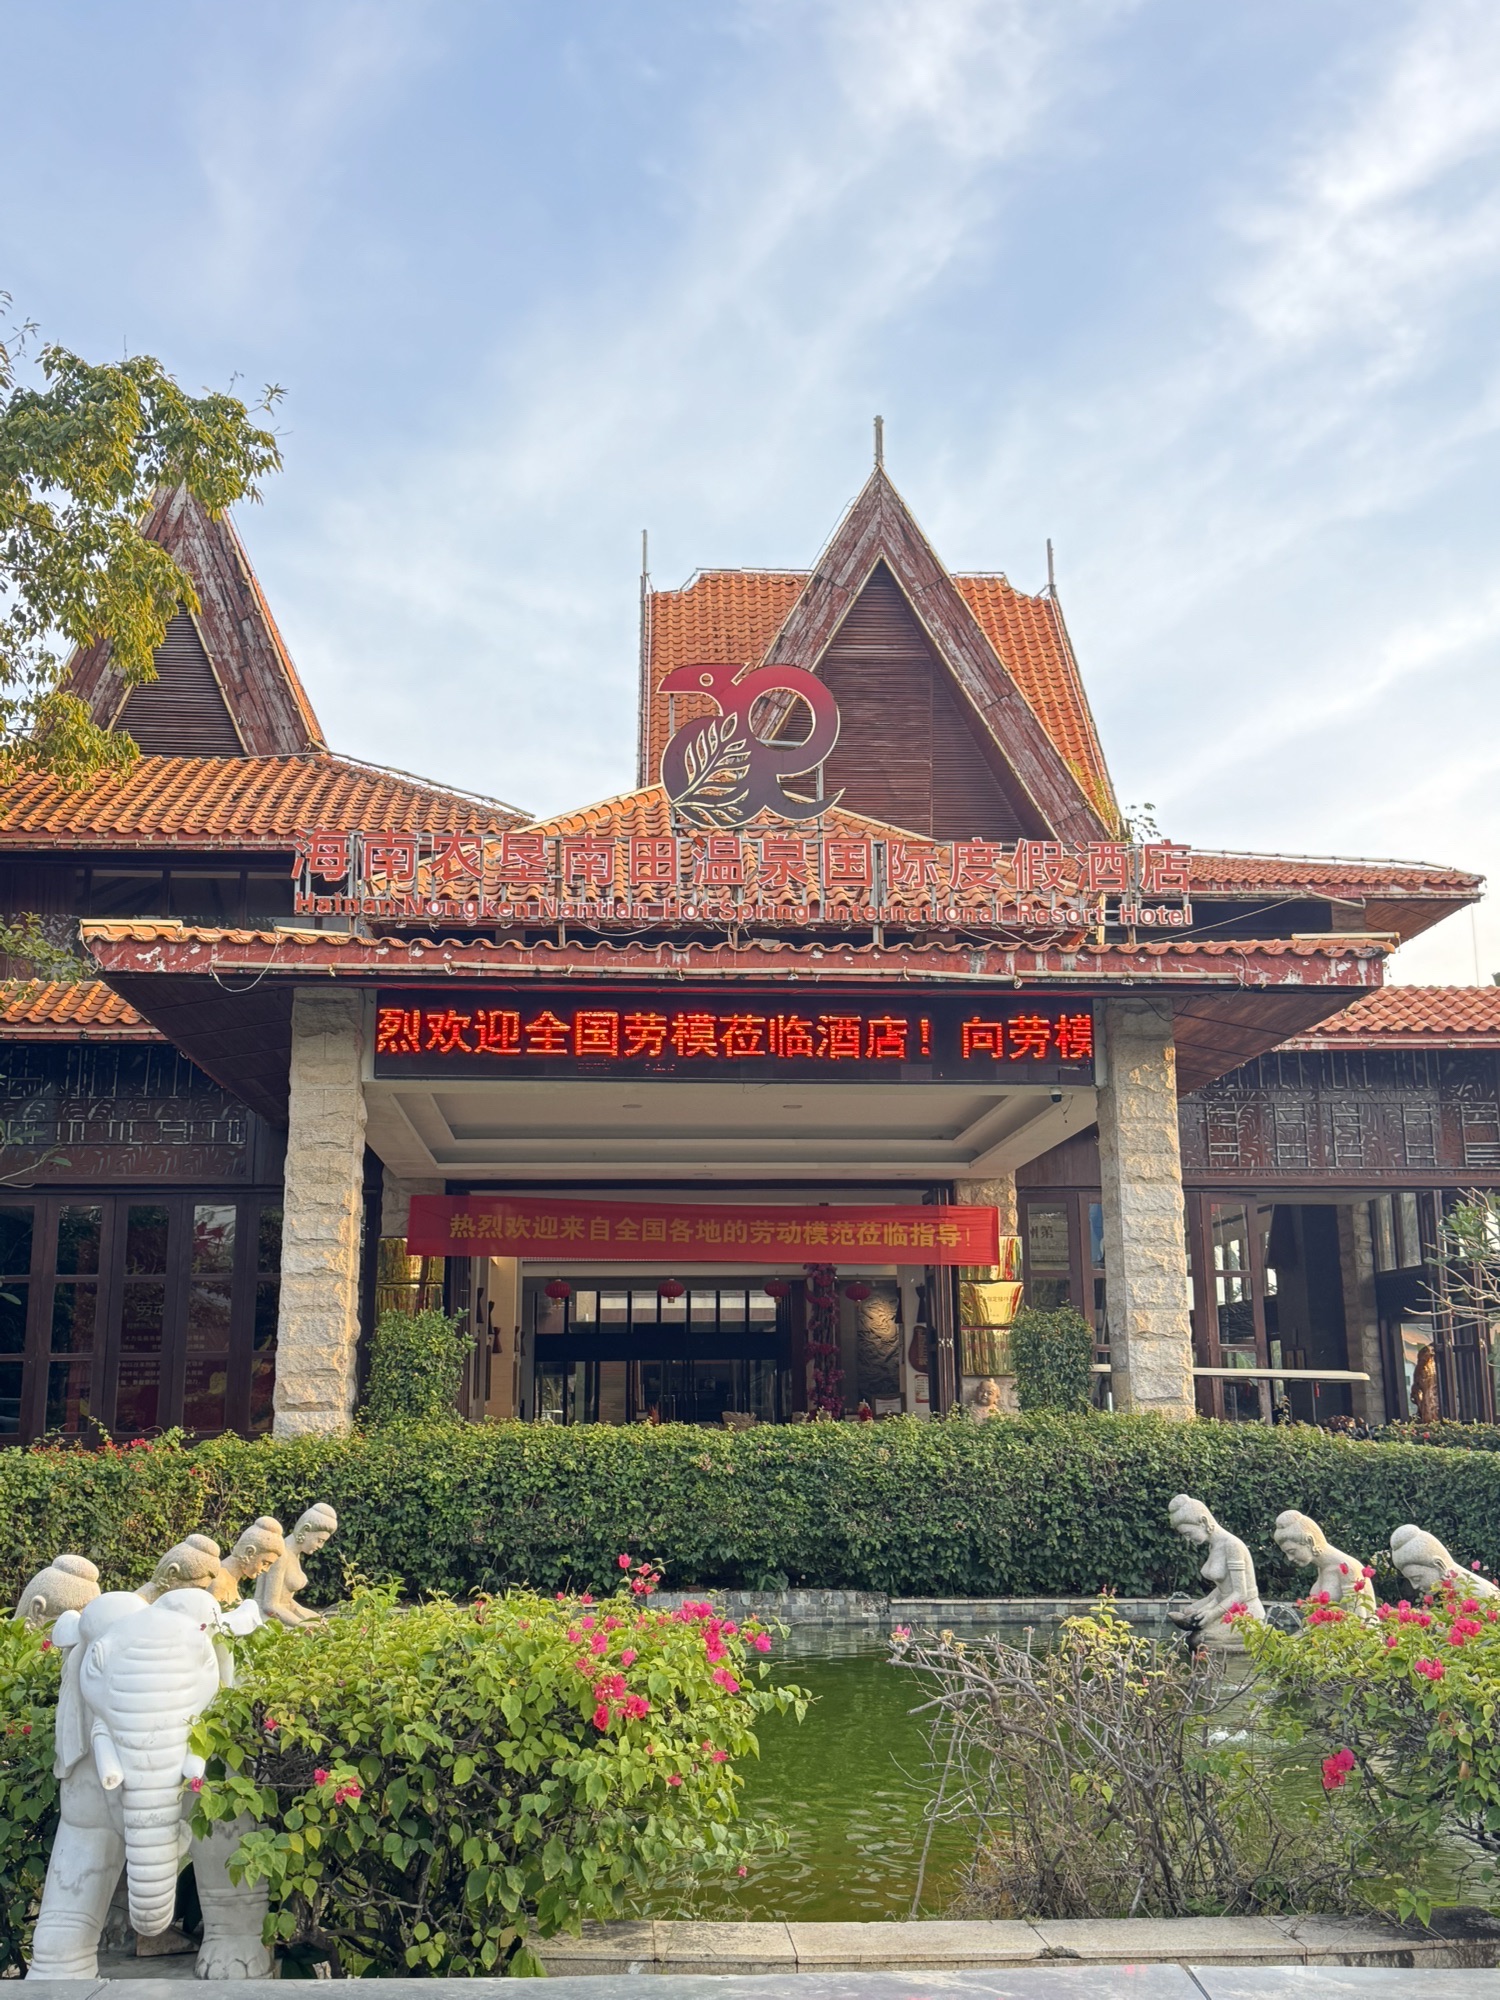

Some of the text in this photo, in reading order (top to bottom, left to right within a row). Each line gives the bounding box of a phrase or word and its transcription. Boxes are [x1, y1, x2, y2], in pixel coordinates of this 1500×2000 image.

[290, 827, 1192, 893] 海南农垦南田温泉国际度假酒店
[295, 892, 1194, 926] Hainan Nongken Nantian Hot Spring International Resort Hotel
[450, 1213, 970, 1248] 热烈欢迎来自全国各地的劳动模范莅临指导！
